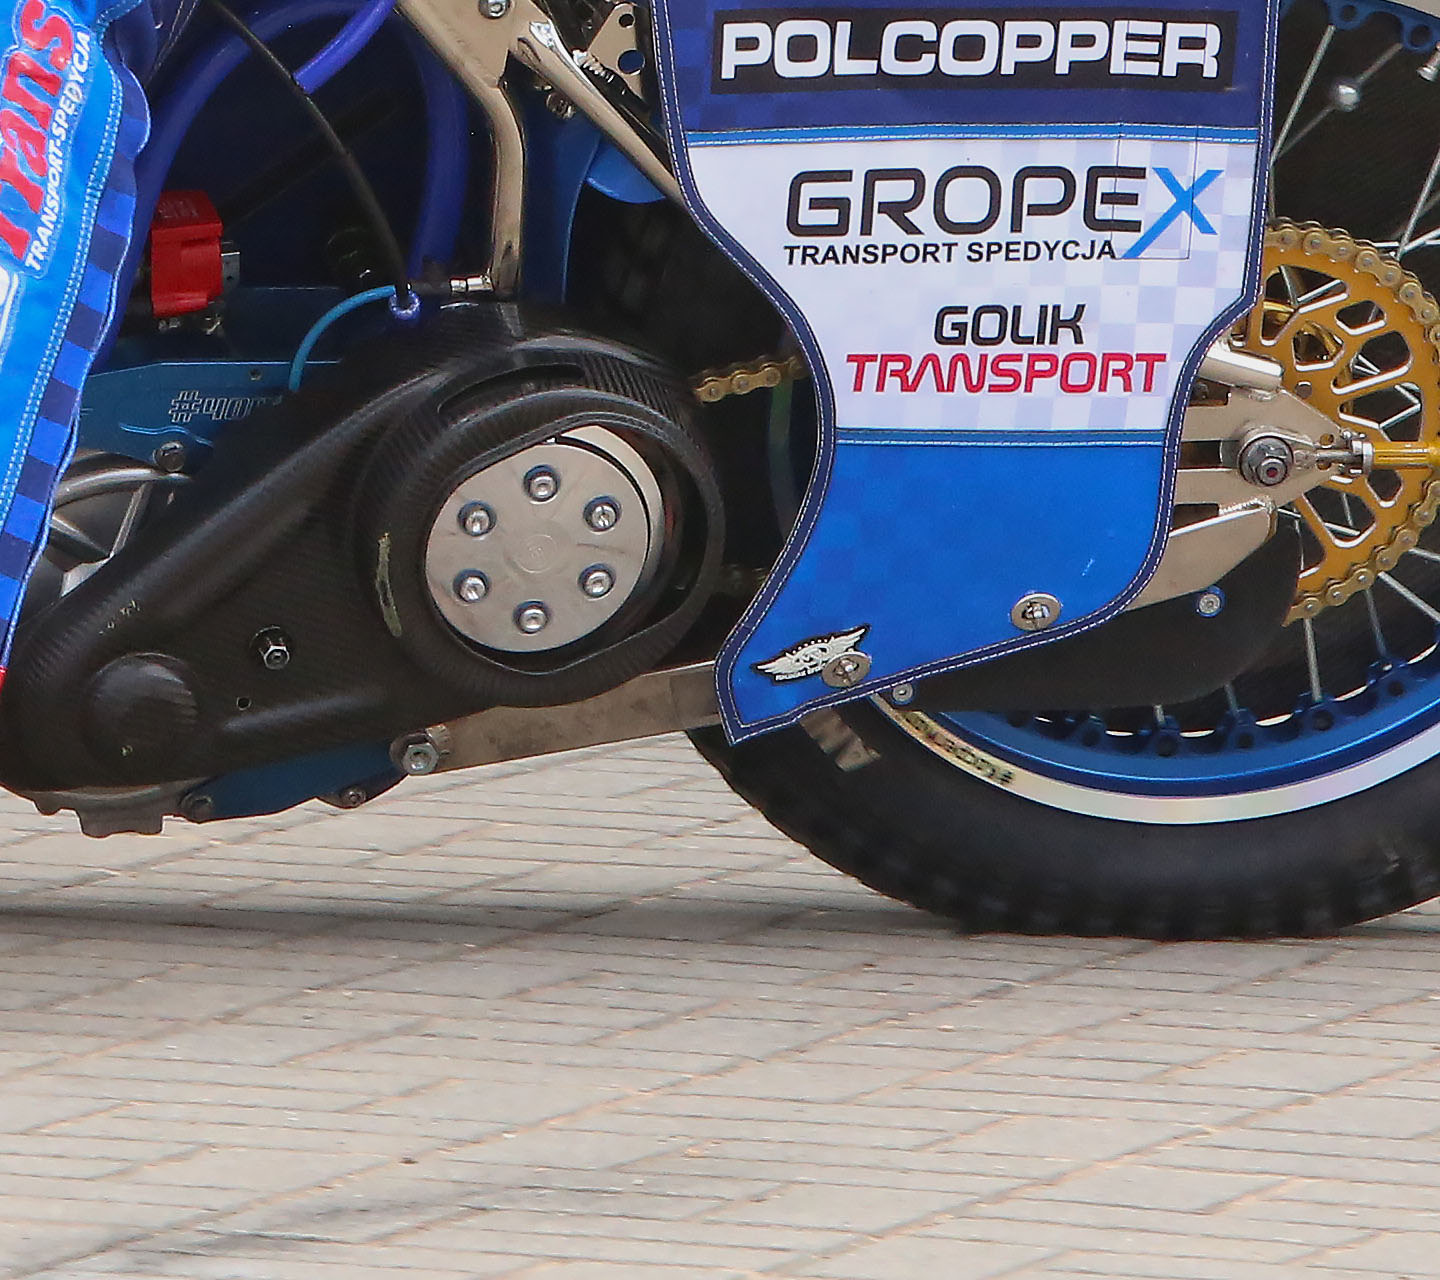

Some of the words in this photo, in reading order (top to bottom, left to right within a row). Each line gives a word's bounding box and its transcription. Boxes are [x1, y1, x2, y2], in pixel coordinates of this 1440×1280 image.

[720, 19, 1221, 80] POLCOPPER
[25, 30, 91, 274] TRANSPORT-SPEDYCJA
[785, 164, 1225, 261] GROPEX
[783, 243, 956, 266] TRANSPORT
[965, 241, 1118, 265] SPEDYCJA
[933, 304, 1086, 346] GOLIK
[845, 352, 1169, 395] TRANSPORT
